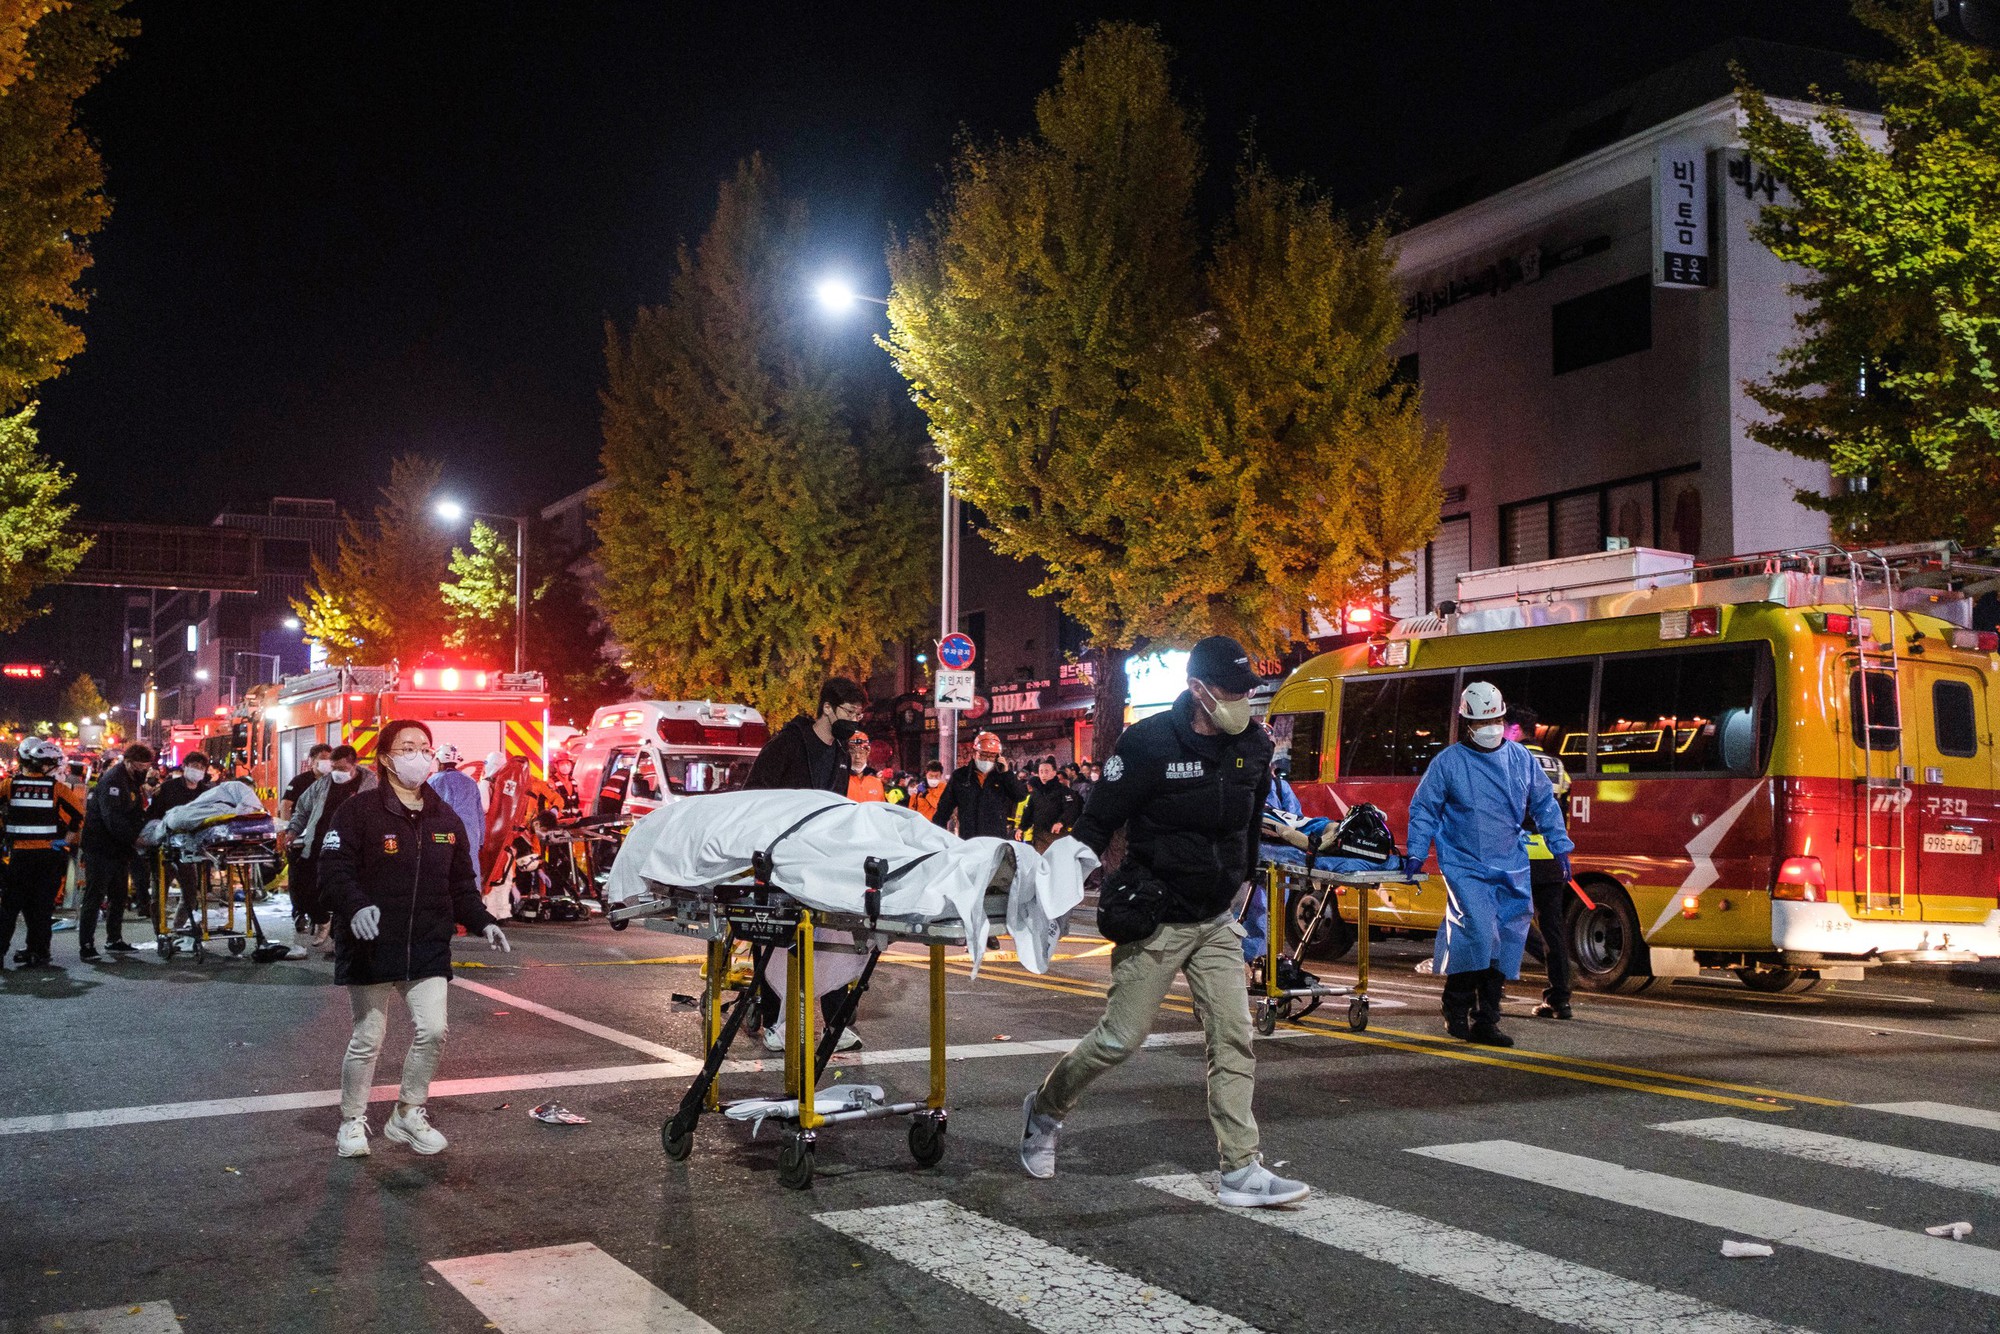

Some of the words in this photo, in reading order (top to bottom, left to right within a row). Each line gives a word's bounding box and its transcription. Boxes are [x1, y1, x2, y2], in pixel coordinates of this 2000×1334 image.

[1728, 154, 1785, 203] 빅사
[1672, 160, 1697, 246] 빅톰
[1671, 257, 1701, 282] 큰옷
[943, 648, 970, 656] 주차금지
[939, 675, 972, 686] 견인지역
[991, 691, 1041, 714] HULK
[1482, 707, 1497, 715] 119
[1572, 796, 1591, 823] 대
[1871, 787, 1913, 813] 119
[1926, 797, 1968, 817] 구조대
[741, 922, 784, 935] SAVER
